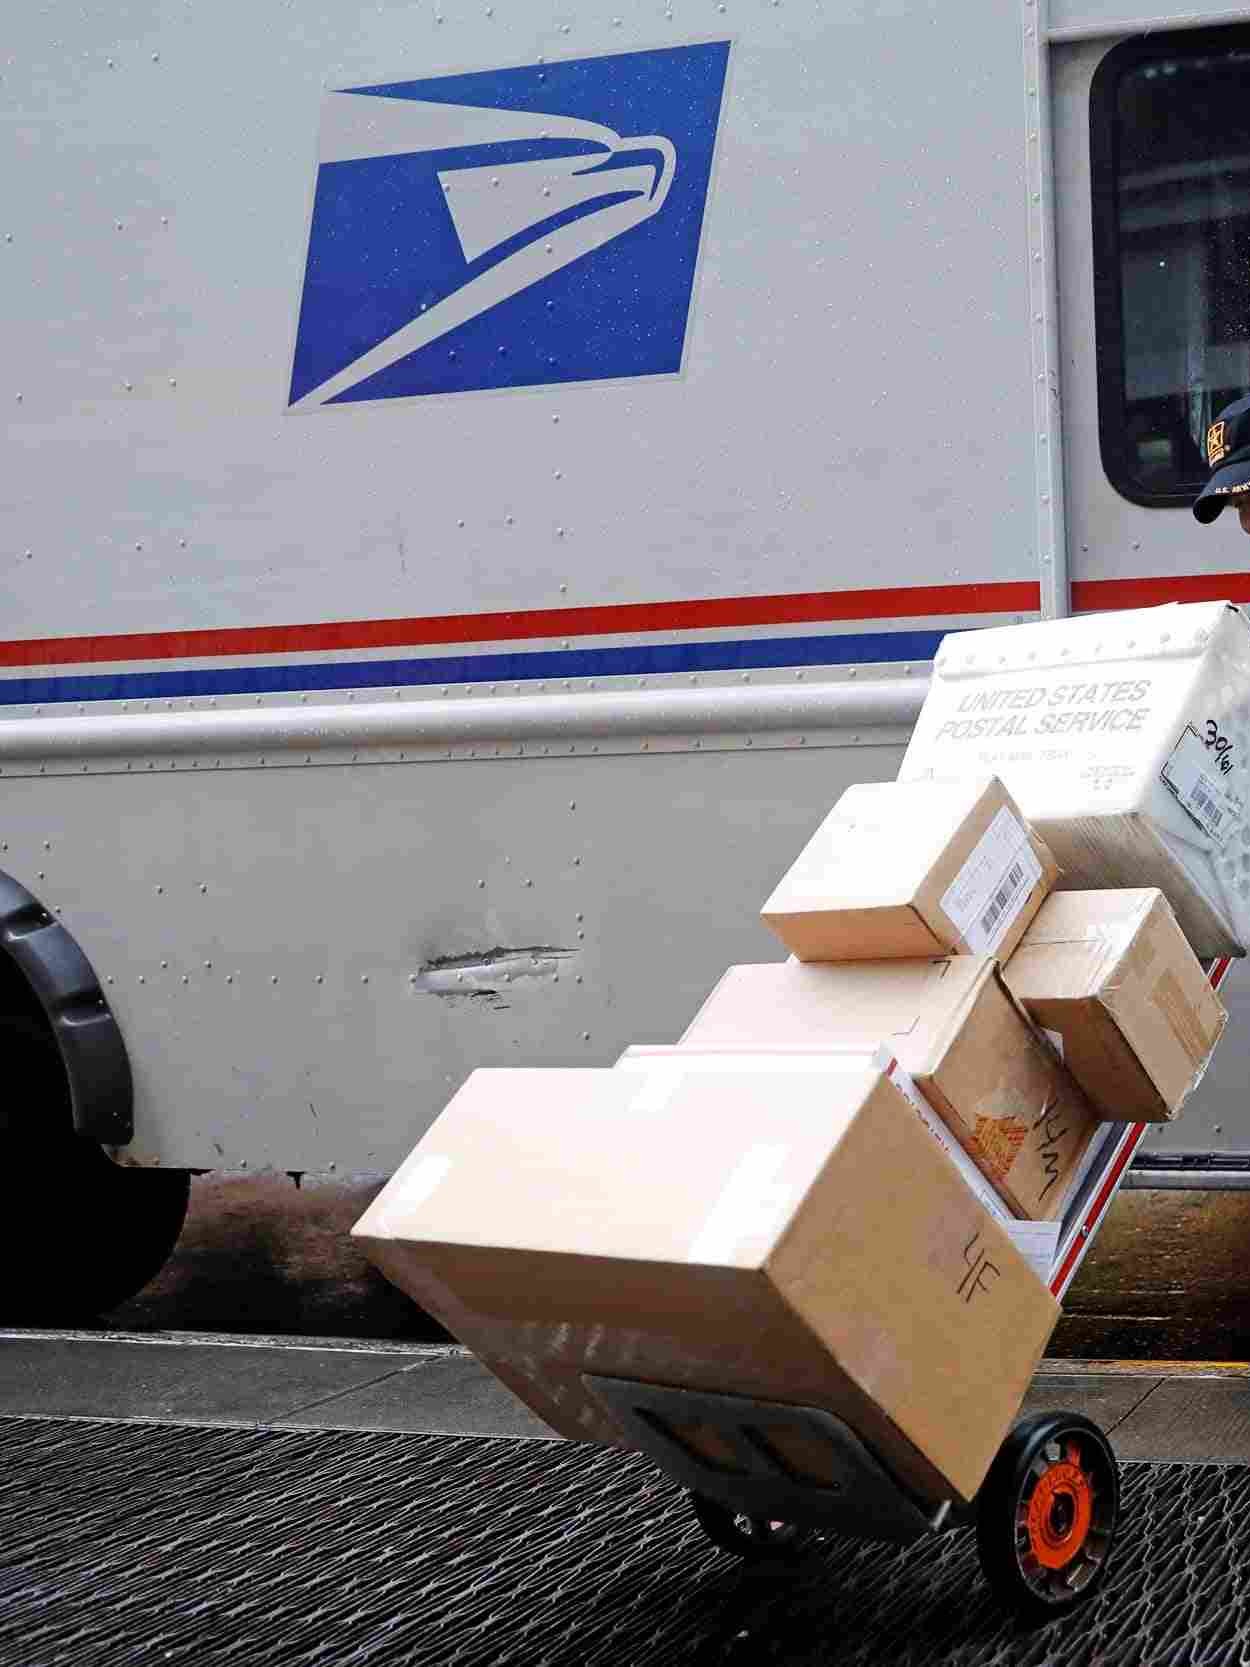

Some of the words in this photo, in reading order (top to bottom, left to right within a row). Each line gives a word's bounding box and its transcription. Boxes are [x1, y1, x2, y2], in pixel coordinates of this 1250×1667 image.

[957, 688, 1047, 712] UNITED
[1048, 680, 1152, 706] STATES
[935, 714, 1028, 741] POSTAL
[1034, 708, 1152, 734] SERVICE
